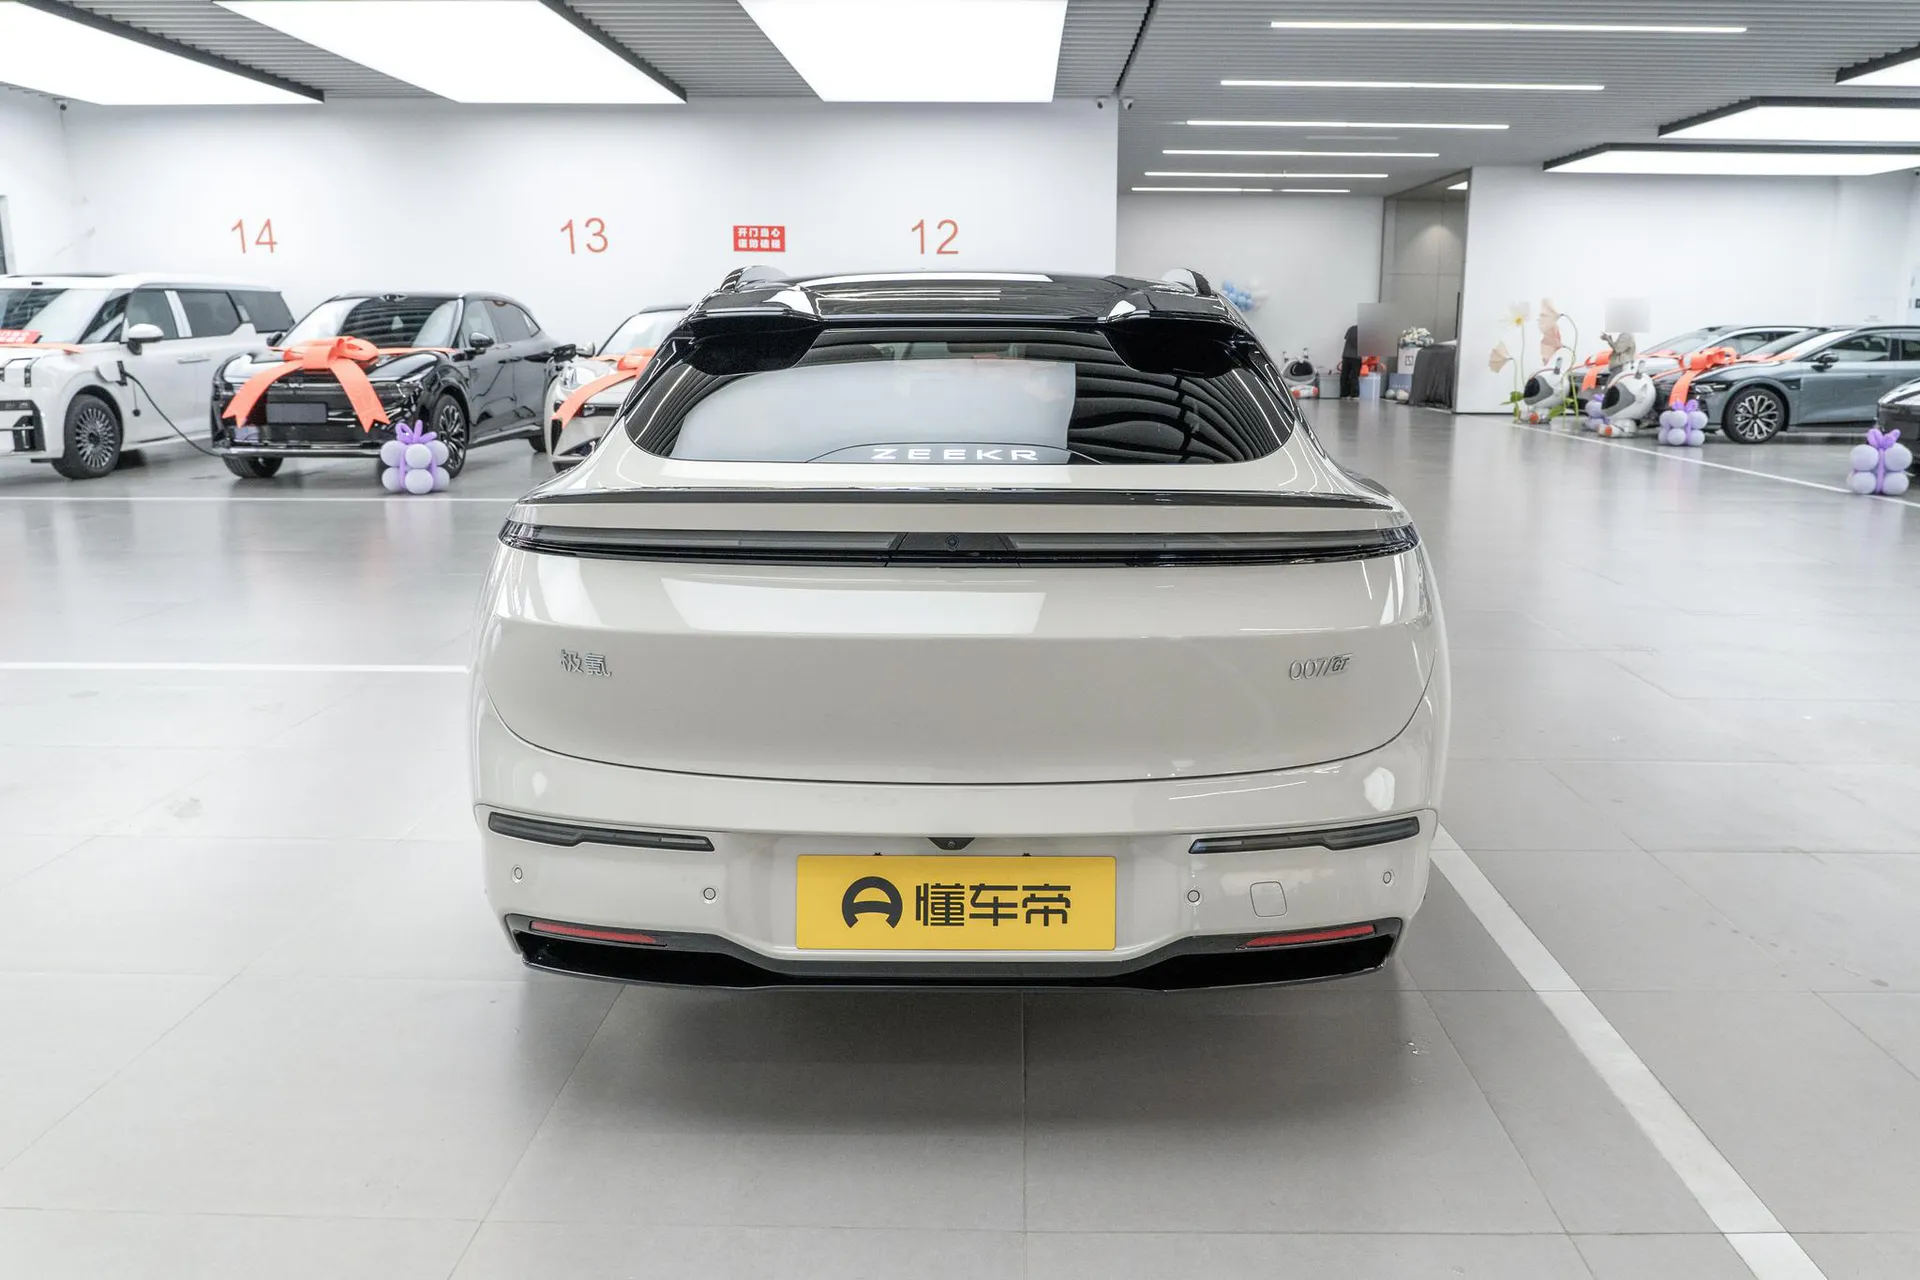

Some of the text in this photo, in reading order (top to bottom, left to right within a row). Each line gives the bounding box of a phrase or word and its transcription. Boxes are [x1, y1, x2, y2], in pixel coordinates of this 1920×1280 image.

[231, 218, 278, 254] 14
[560, 217, 608, 254] 13
[737, 227, 781, 238] 开门当心
[911, 218, 959, 254] 12
[871, 448, 1038, 460] ZEEKR
[560, 648, 612, 677] 极氪
[915, 883, 1071, 927] 懂车帝
